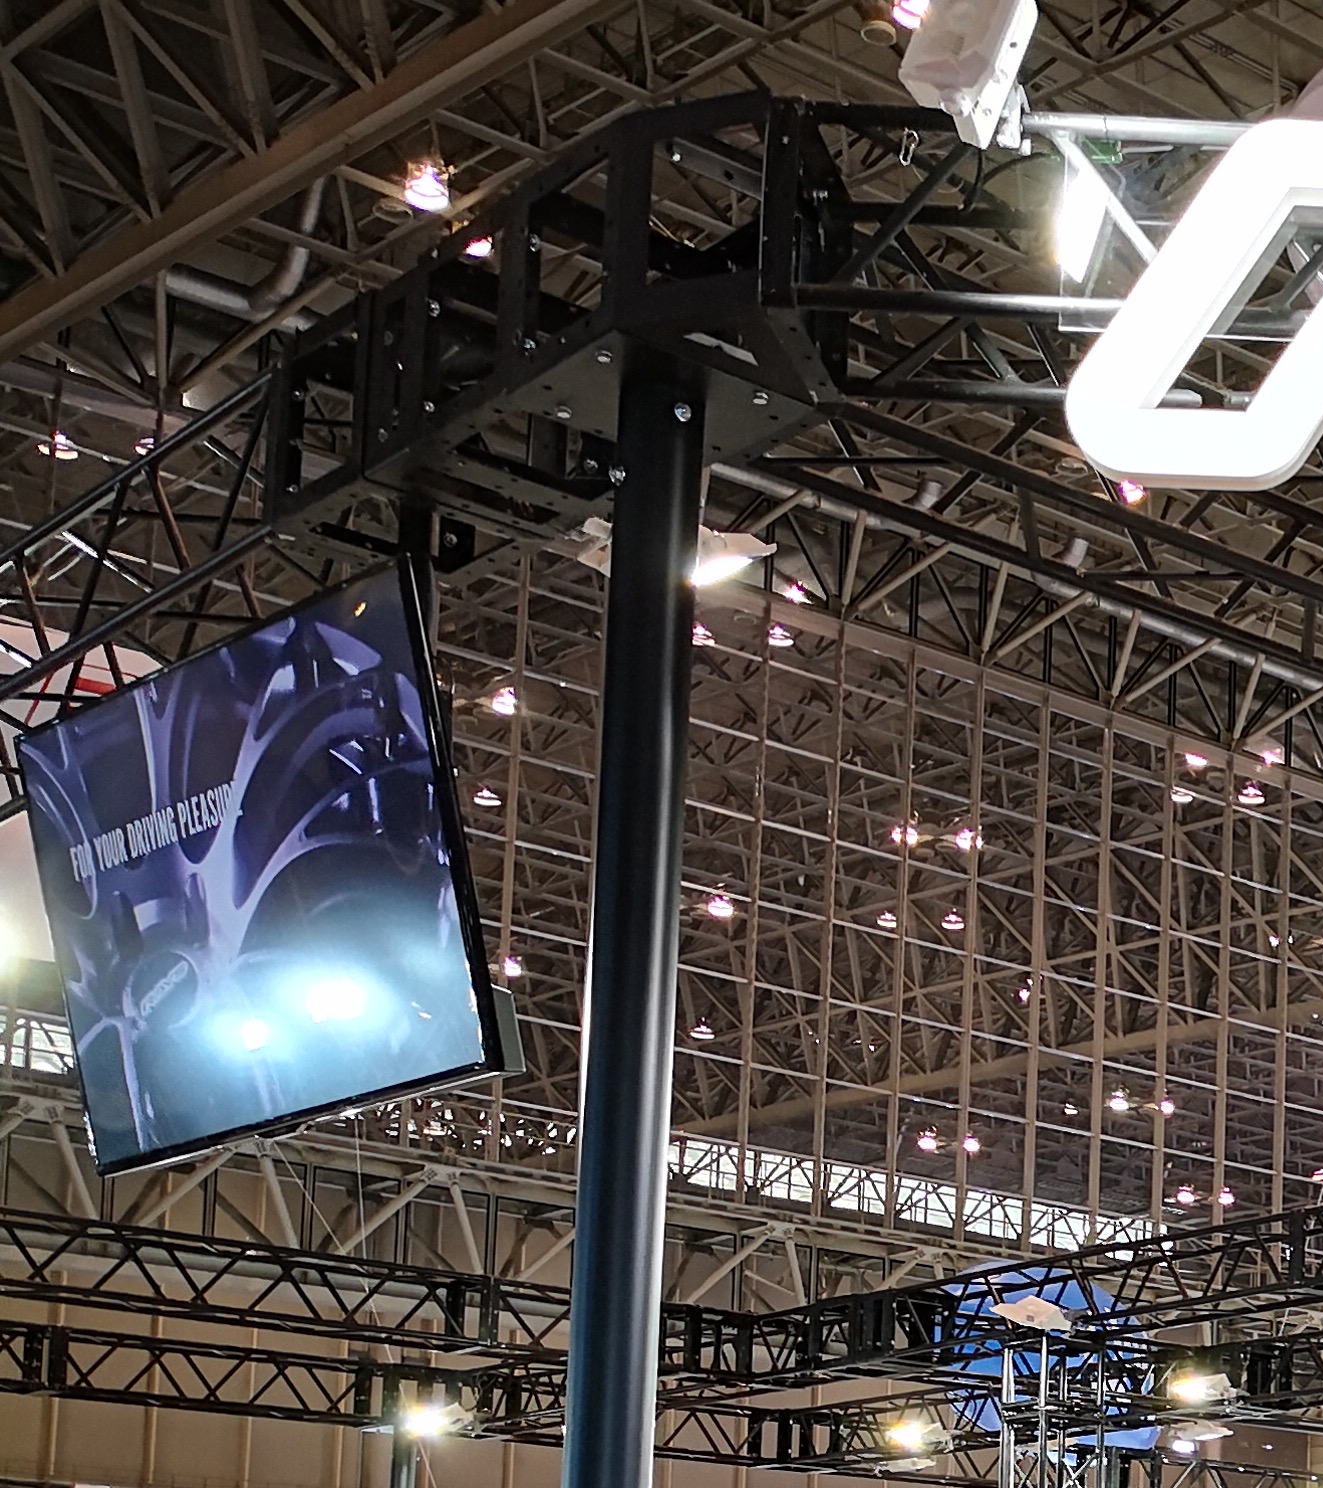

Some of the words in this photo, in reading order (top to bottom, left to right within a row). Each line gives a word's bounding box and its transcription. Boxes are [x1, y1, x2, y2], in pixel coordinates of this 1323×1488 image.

[70, 840, 95, 882] FOR
[93, 828, 128, 872] YOUR
[126, 806, 179, 859] DRIVING
